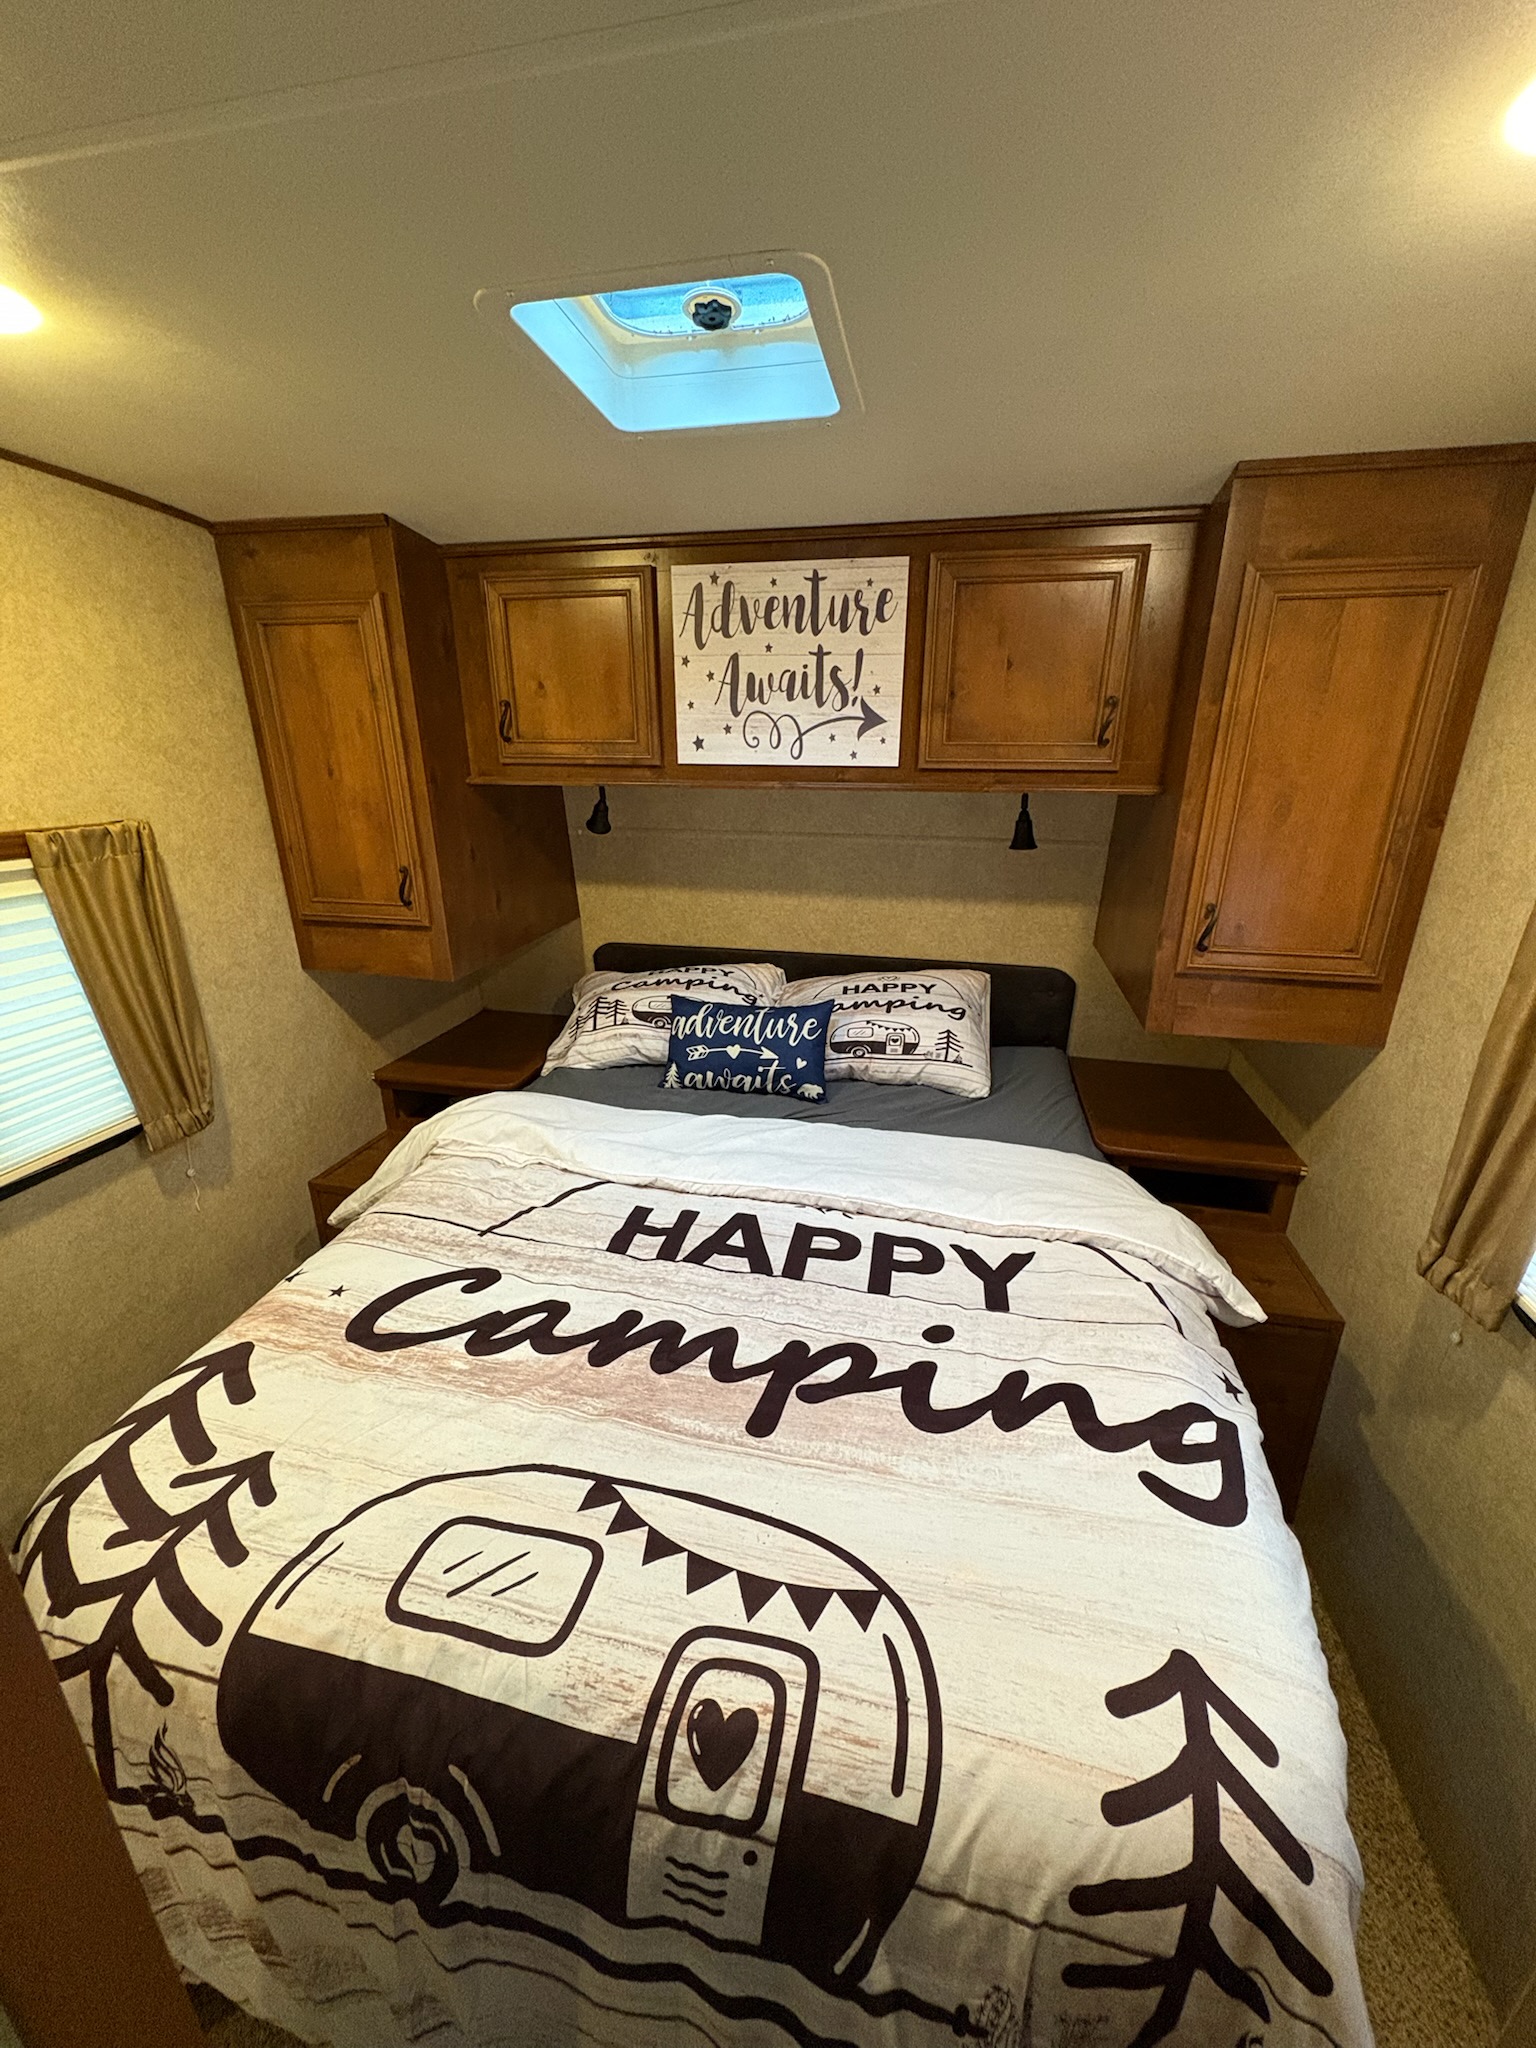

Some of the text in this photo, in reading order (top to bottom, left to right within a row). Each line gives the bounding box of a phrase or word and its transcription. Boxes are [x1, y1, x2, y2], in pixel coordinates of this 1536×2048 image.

[679, 569, 898, 650] Adventure
[714, 644, 864, 718] Awaits!
[832, 996, 967, 1021] amping
[842, 983, 937, 995] HAPPY
[671, 1003, 822, 1047] adventure
[683, 1059, 797, 1094] awaits
[606, 1204, 1036, 1312] HAPPY
[345, 1267, 1249, 1528] Camping
